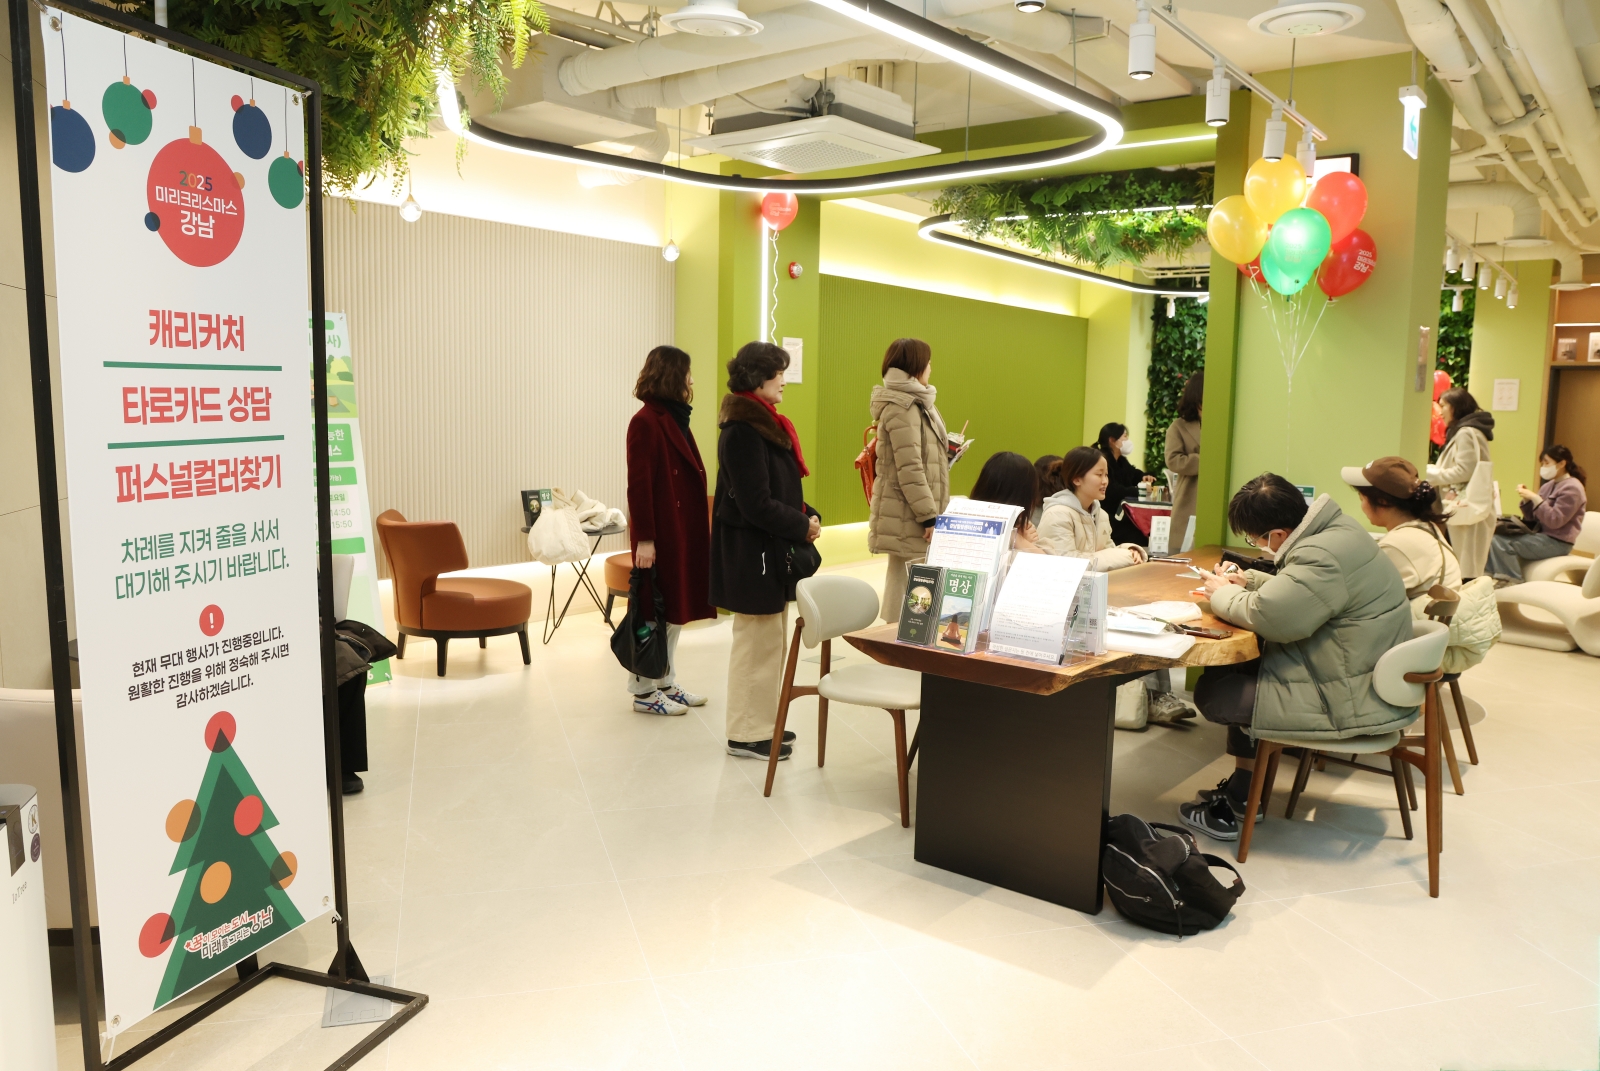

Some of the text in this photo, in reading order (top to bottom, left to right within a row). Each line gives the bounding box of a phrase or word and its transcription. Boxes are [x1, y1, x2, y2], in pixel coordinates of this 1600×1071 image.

[179, 170, 213, 192] 2025
[155, 185, 238, 216] 미리크리스마스
[180, 209, 215, 239] 강남
[1353, 261, 1370, 273] 강남
[1358, 249, 1373, 259] 2025
[149, 309, 245, 352] 캐리커처
[122, 386, 272, 425] 타로카드 상담
[115, 454, 282, 503] 퍼스널컬러찾기
[121, 517, 280, 563] 차례를 지켜 줄을 서서
[332, 519, 353, 529] 15:50
[115, 547, 290, 600] 대기해 주시기 바랍니다.
[949, 578, 972, 595] 명상
[131, 625, 285, 678] 현재 무대 행사가 진행중입니다.
[127, 643, 290, 702] 원활한 진행을 위해 정숙해 주시면
[175, 673, 255, 709] 감사하겠습니다.
[192, 911, 250, 949] 꿈이 모이는 도시
[201, 905, 274, 959] 미래를 그리는 강남
